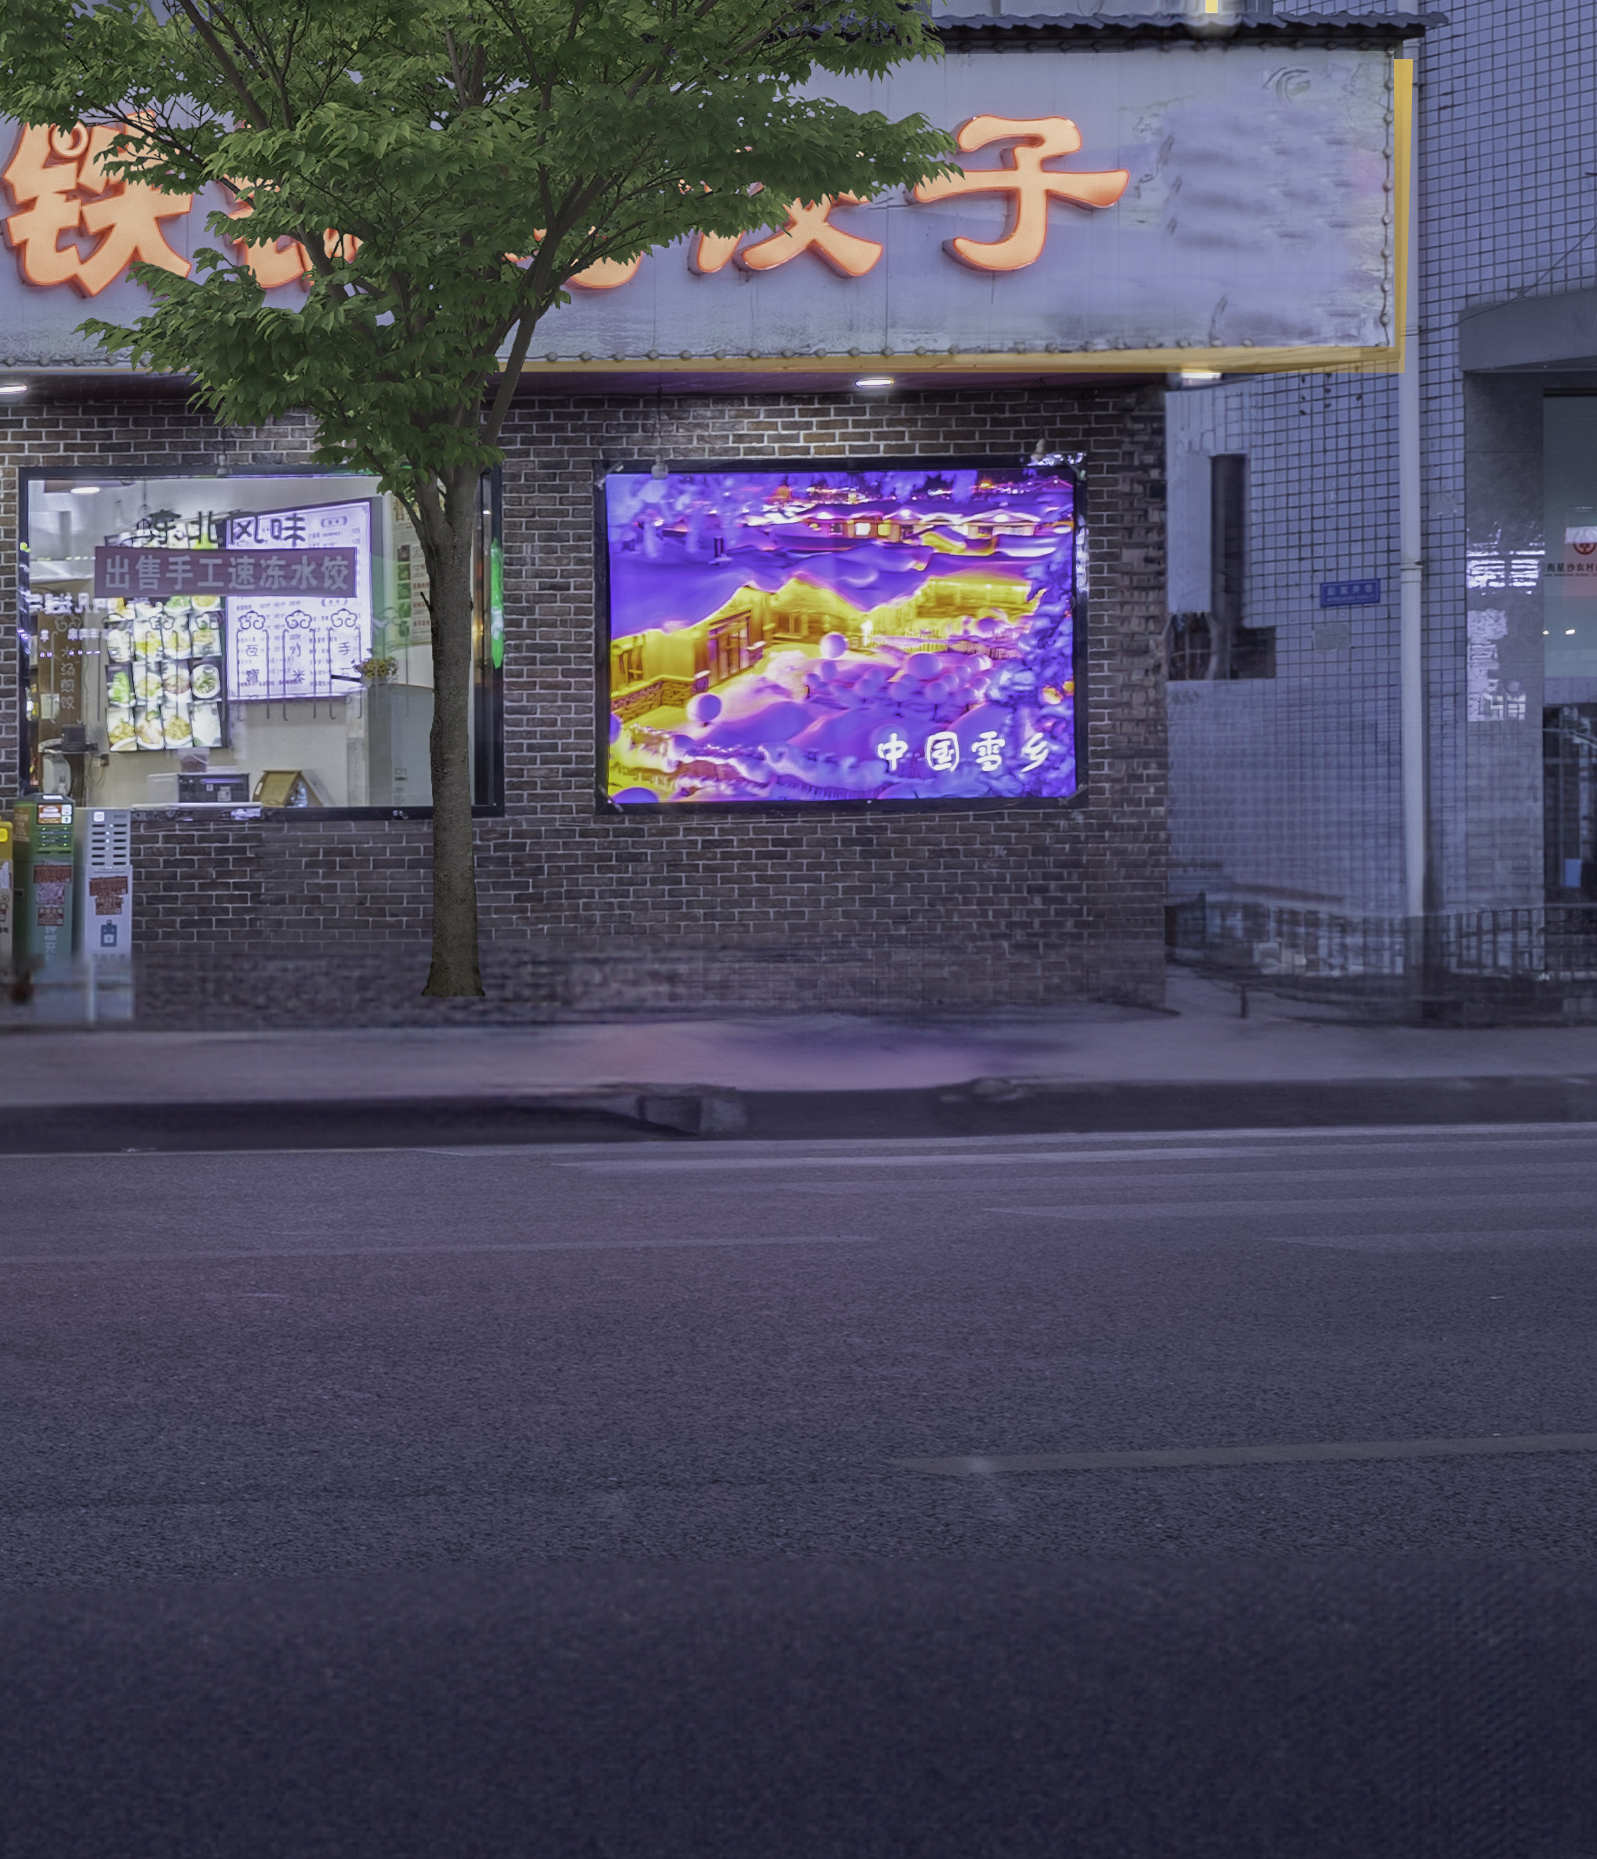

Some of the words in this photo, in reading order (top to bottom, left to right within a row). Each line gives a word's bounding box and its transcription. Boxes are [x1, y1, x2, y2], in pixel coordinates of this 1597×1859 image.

[105, 555, 349, 591] 出售手工速冻水饺
[877, 730, 1050, 772] 中国雪乡
